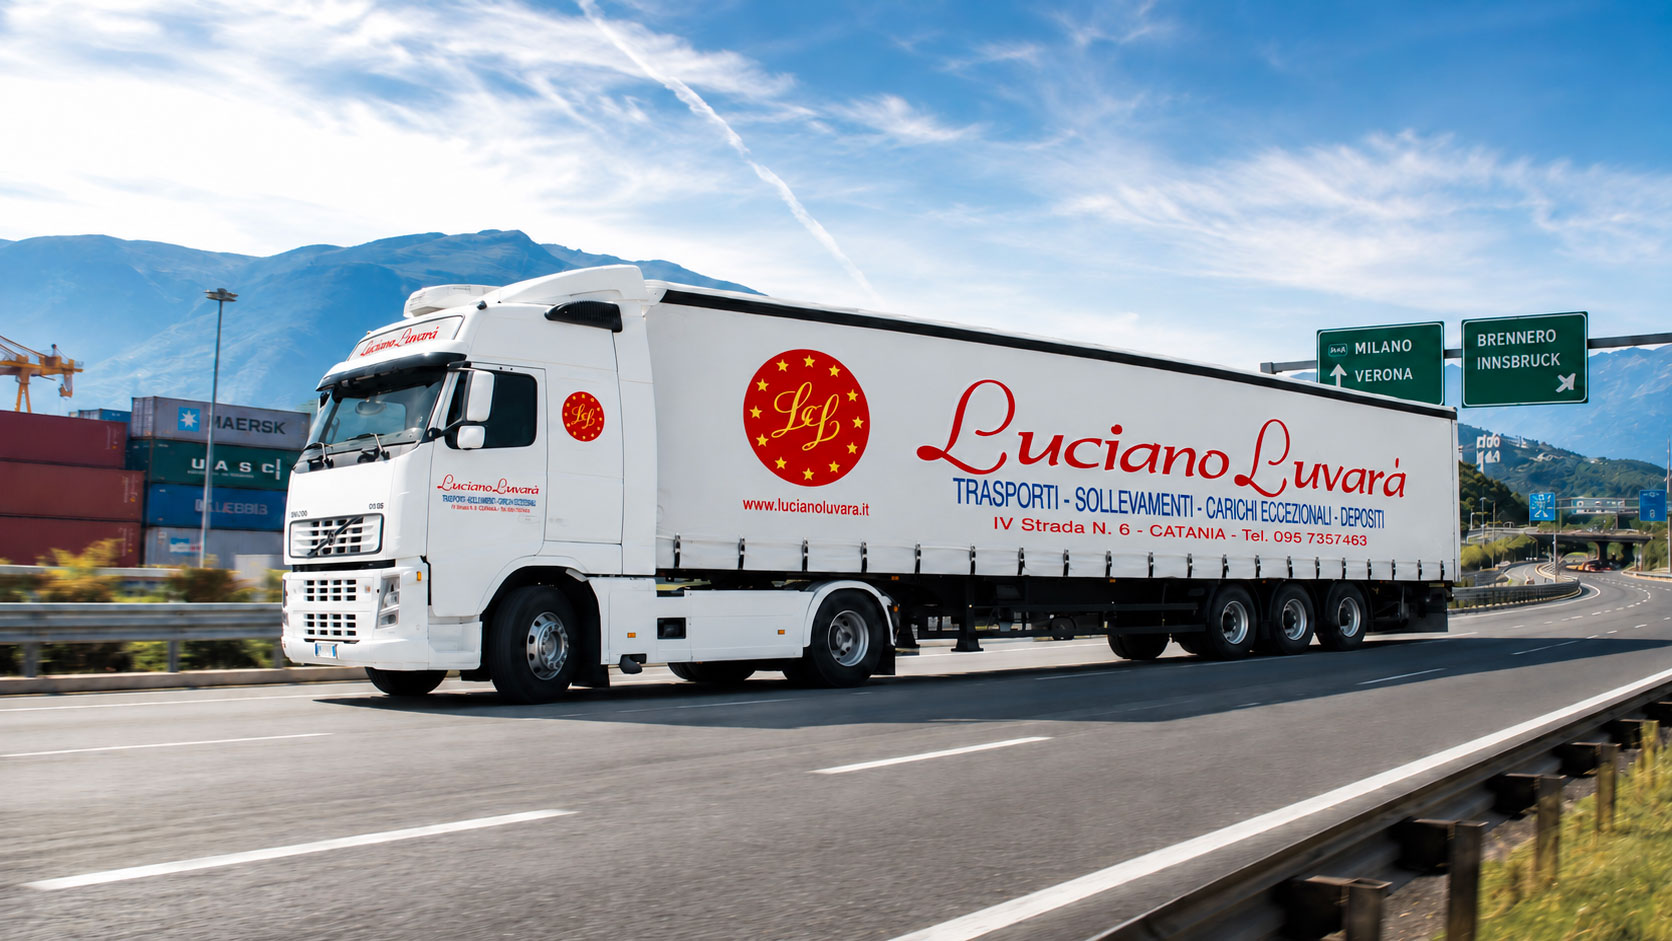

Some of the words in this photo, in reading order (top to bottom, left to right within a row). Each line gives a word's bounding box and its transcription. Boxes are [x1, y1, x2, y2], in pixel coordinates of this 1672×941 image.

[1355, 339, 1413, 355] MILANO
[1477, 329, 1557, 347] BRENNERO
[1477, 352, 1561, 370] INNSBRUCK
[1355, 367, 1413, 382] VERONA
[916, 379, 1230, 480] Luciano
[437, 474, 493, 491] Luciano
[742, 497, 870, 517] www.lucianoluvara.it
[952, 477, 1059, 510] TRASPORTI
[1075, 486, 1193, 518] SOLLEVAMENTI
[1206, 496, 1257, 521] CARICHI
[1261, 500, 1332, 526] ECCEZIONALI
[1341, 506, 1385, 529] DEPOSITI
[993, 516, 1014, 530] IV
[1021, 517, 1085, 534] Strada
[1092, 521, 1112, 535] N.
[1119, 523, 1130, 536] 6
[1149, 524, 1226, 540] CATANIA
[1242, 529, 1269, 543] Tel.
[1273, 531, 1303, 544] 095
[1307, 533, 1368, 547] 7357463
